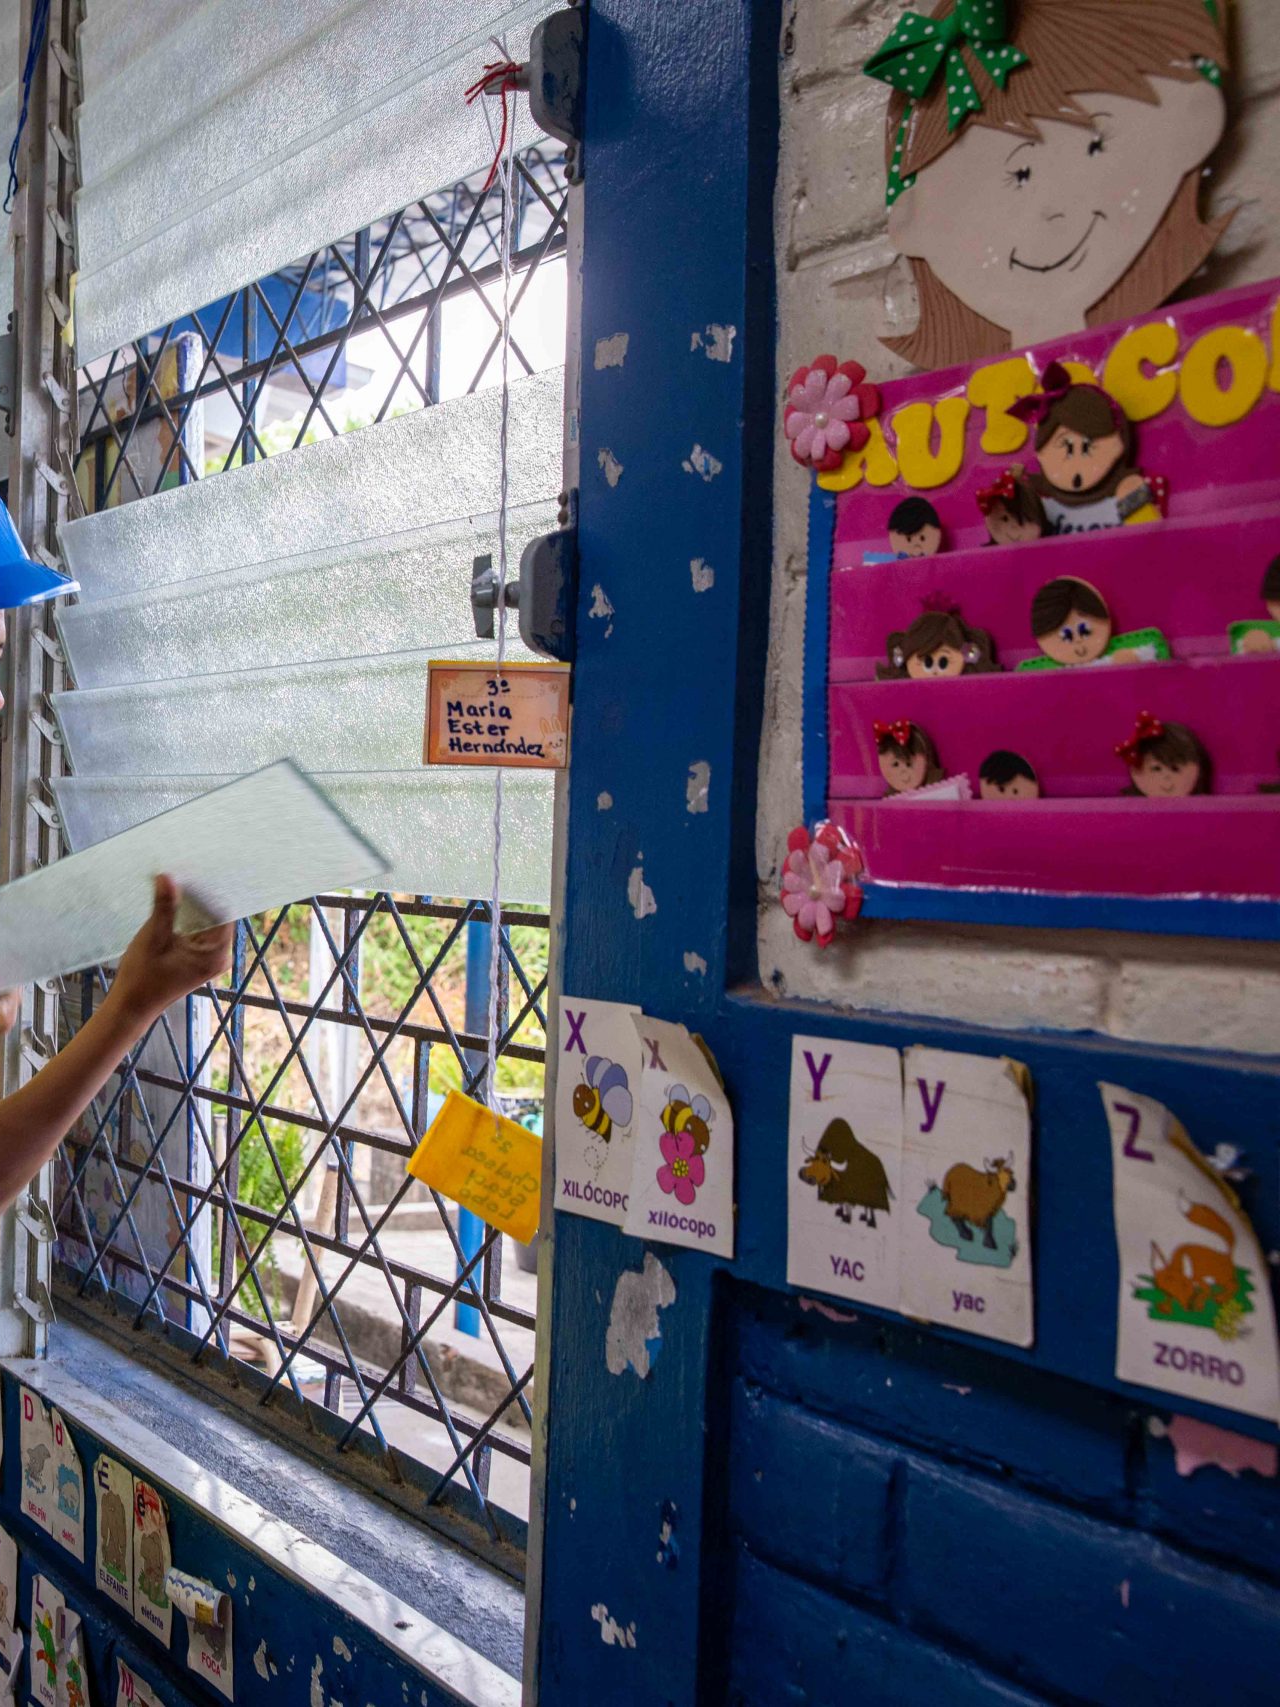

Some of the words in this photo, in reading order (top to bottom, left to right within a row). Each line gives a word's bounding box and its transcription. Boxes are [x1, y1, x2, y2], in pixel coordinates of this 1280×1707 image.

[817, 295, 1280, 492] AUTCO
[448, 718, 510, 736] Ester
[564, 1009, 588, 1054] X
[803, 1051, 832, 1101] Y
[917, 1077, 945, 1133] y
[1114, 1102, 1155, 1163] Z
[830, 1255, 865, 1282] YAC
[952, 1289, 985, 1314] yac
[1153, 1342, 1245, 1386] ZORRO
[24, 1394, 34, 1422] D
[55, 1422, 63, 1446] d
[97, 1461, 110, 1491] E
[137, 1492, 146, 1518] e
[35, 1578, 44, 1609] L
[99, 1568, 129, 1600] ELEFANTE
[141, 1605, 164, 1630] elefante
[201, 1652, 221, 1676] FOCA
[121, 1666, 134, 1700] M
